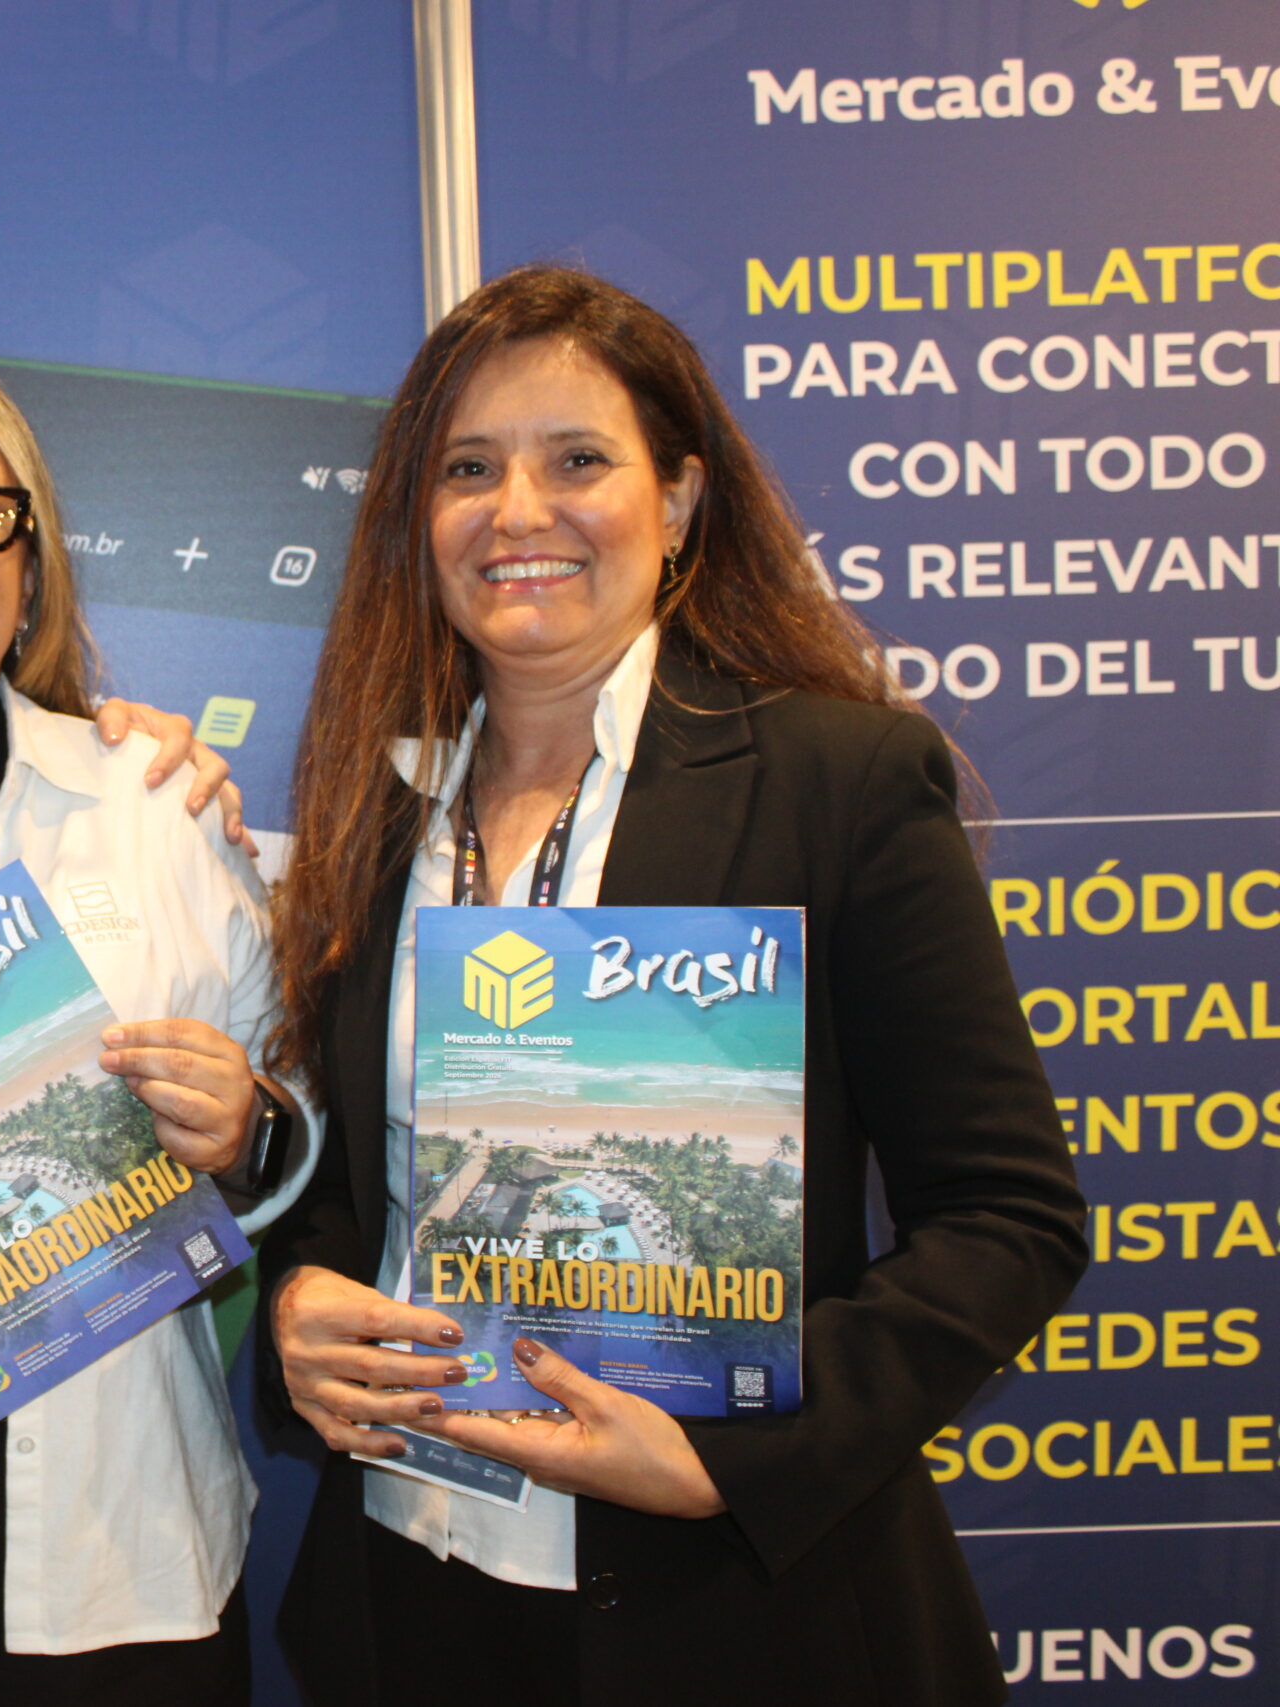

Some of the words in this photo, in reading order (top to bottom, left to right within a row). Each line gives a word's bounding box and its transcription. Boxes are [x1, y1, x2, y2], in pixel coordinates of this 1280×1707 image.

[747, 59, 1075, 125] Mercado
[1096, 57, 1158, 115] &
[1174, 55, 1280, 112] Ev
[746, 242, 1280, 315] MULTIPLATFO
[743, 339, 959, 400] PARA
[848, 439, 1017, 500] CON
[1038, 432, 1267, 494] TODO
[283, 557, 303, 575] 16
[1026, 639, 1176, 698] DEL
[582, 925, 780, 1008] Brasil
[443, 1032, 502, 1045] Mercado
[505, 1033, 516, 1045] &
[519, 1034, 573, 1046] Eventos
[1020, 981, 1280, 1048] ORTAL
[465, 1237, 545, 1259] VIVE
[557, 1241, 600, 1262] LO
[1088, 1199, 1280, 1263] ISTA
[431, 1252, 785, 1323] EXTRAORDINARIO
[921, 1415, 1280, 1483] SOCIALE
